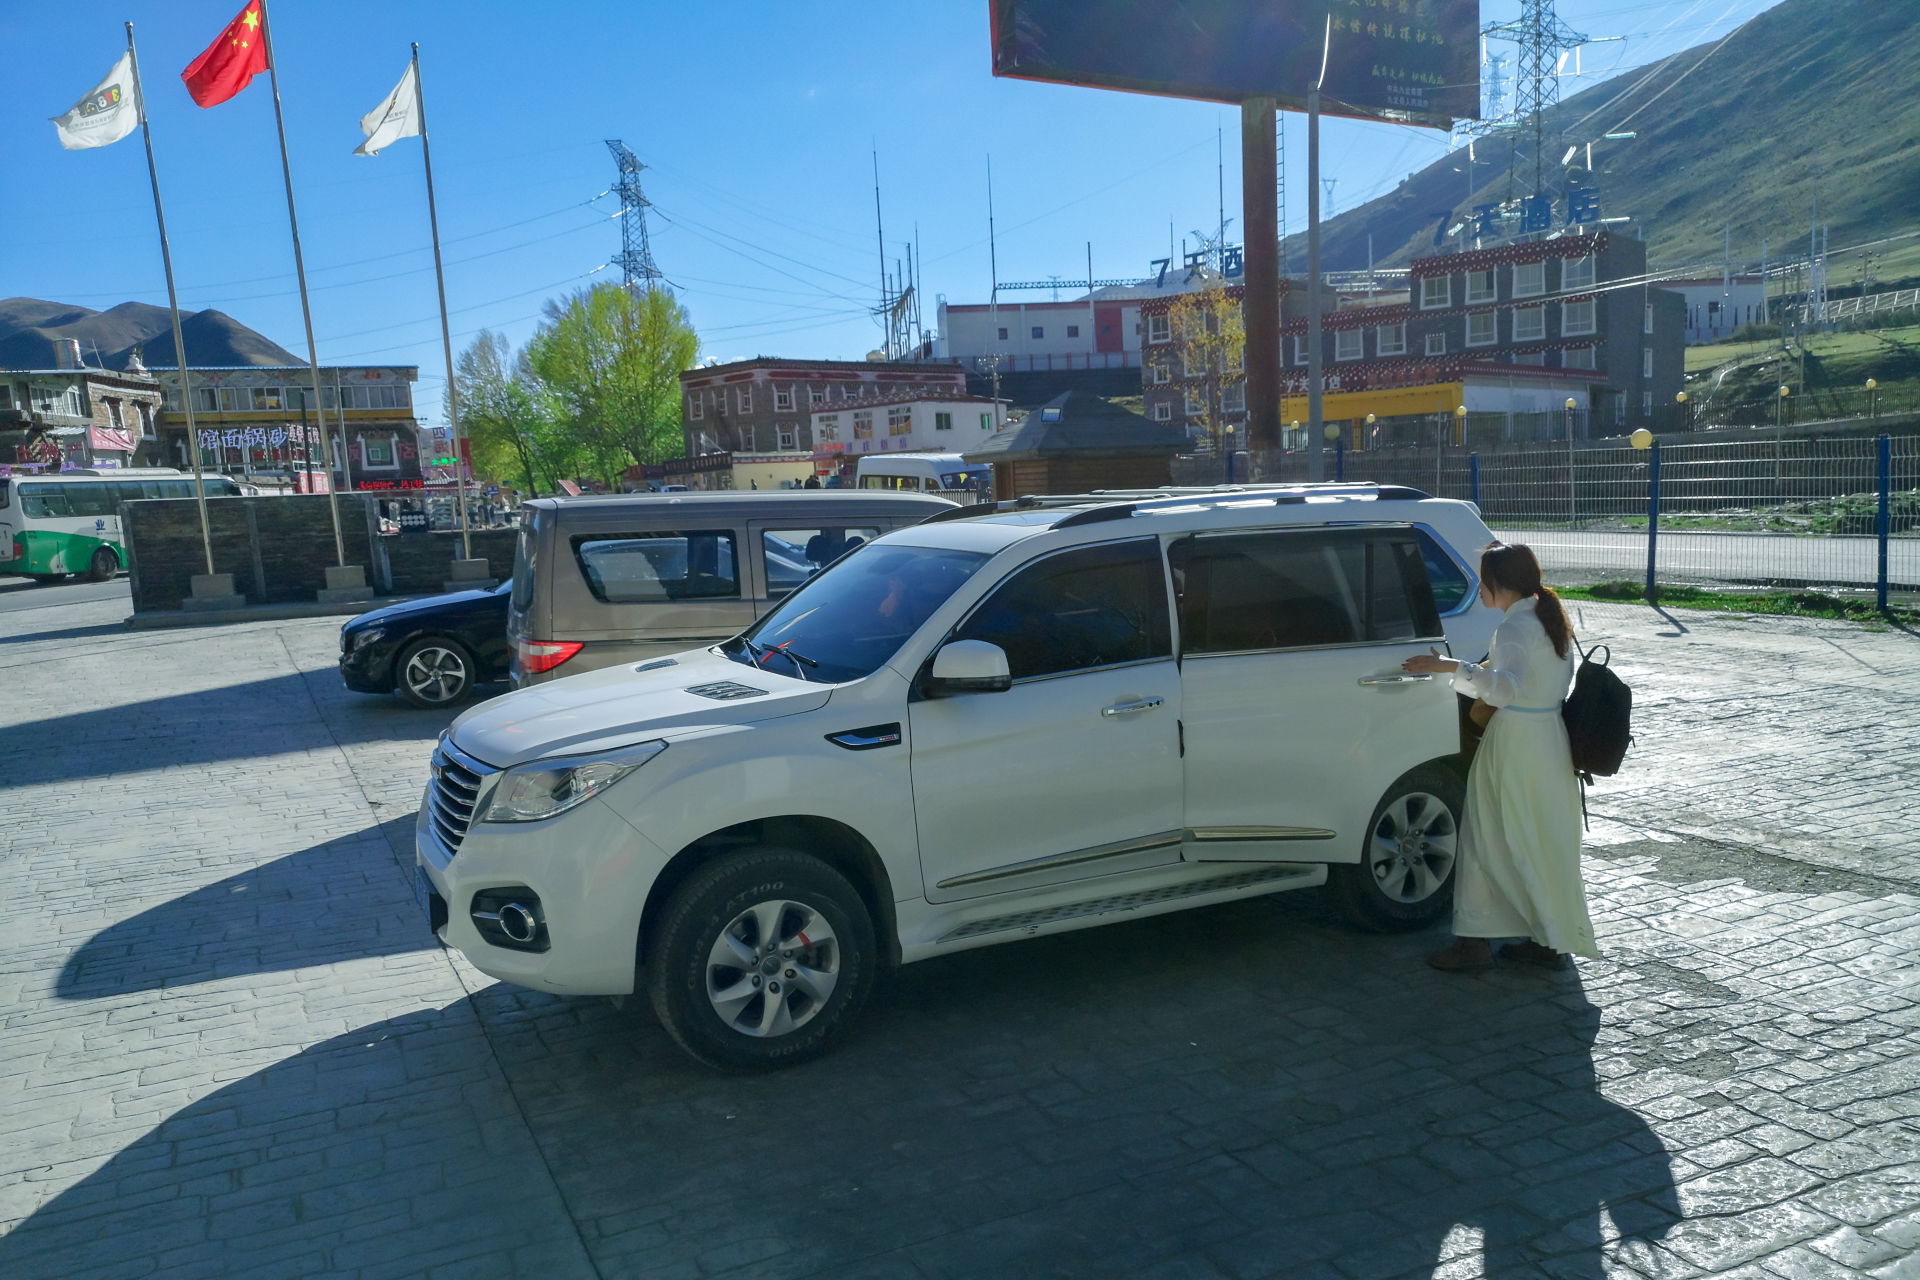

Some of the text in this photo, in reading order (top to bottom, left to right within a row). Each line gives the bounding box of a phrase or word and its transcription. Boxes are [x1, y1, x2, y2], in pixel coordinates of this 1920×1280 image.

[1429, 183, 1601, 247] 7天酒店
[1286, 374, 1341, 393] 7天店
